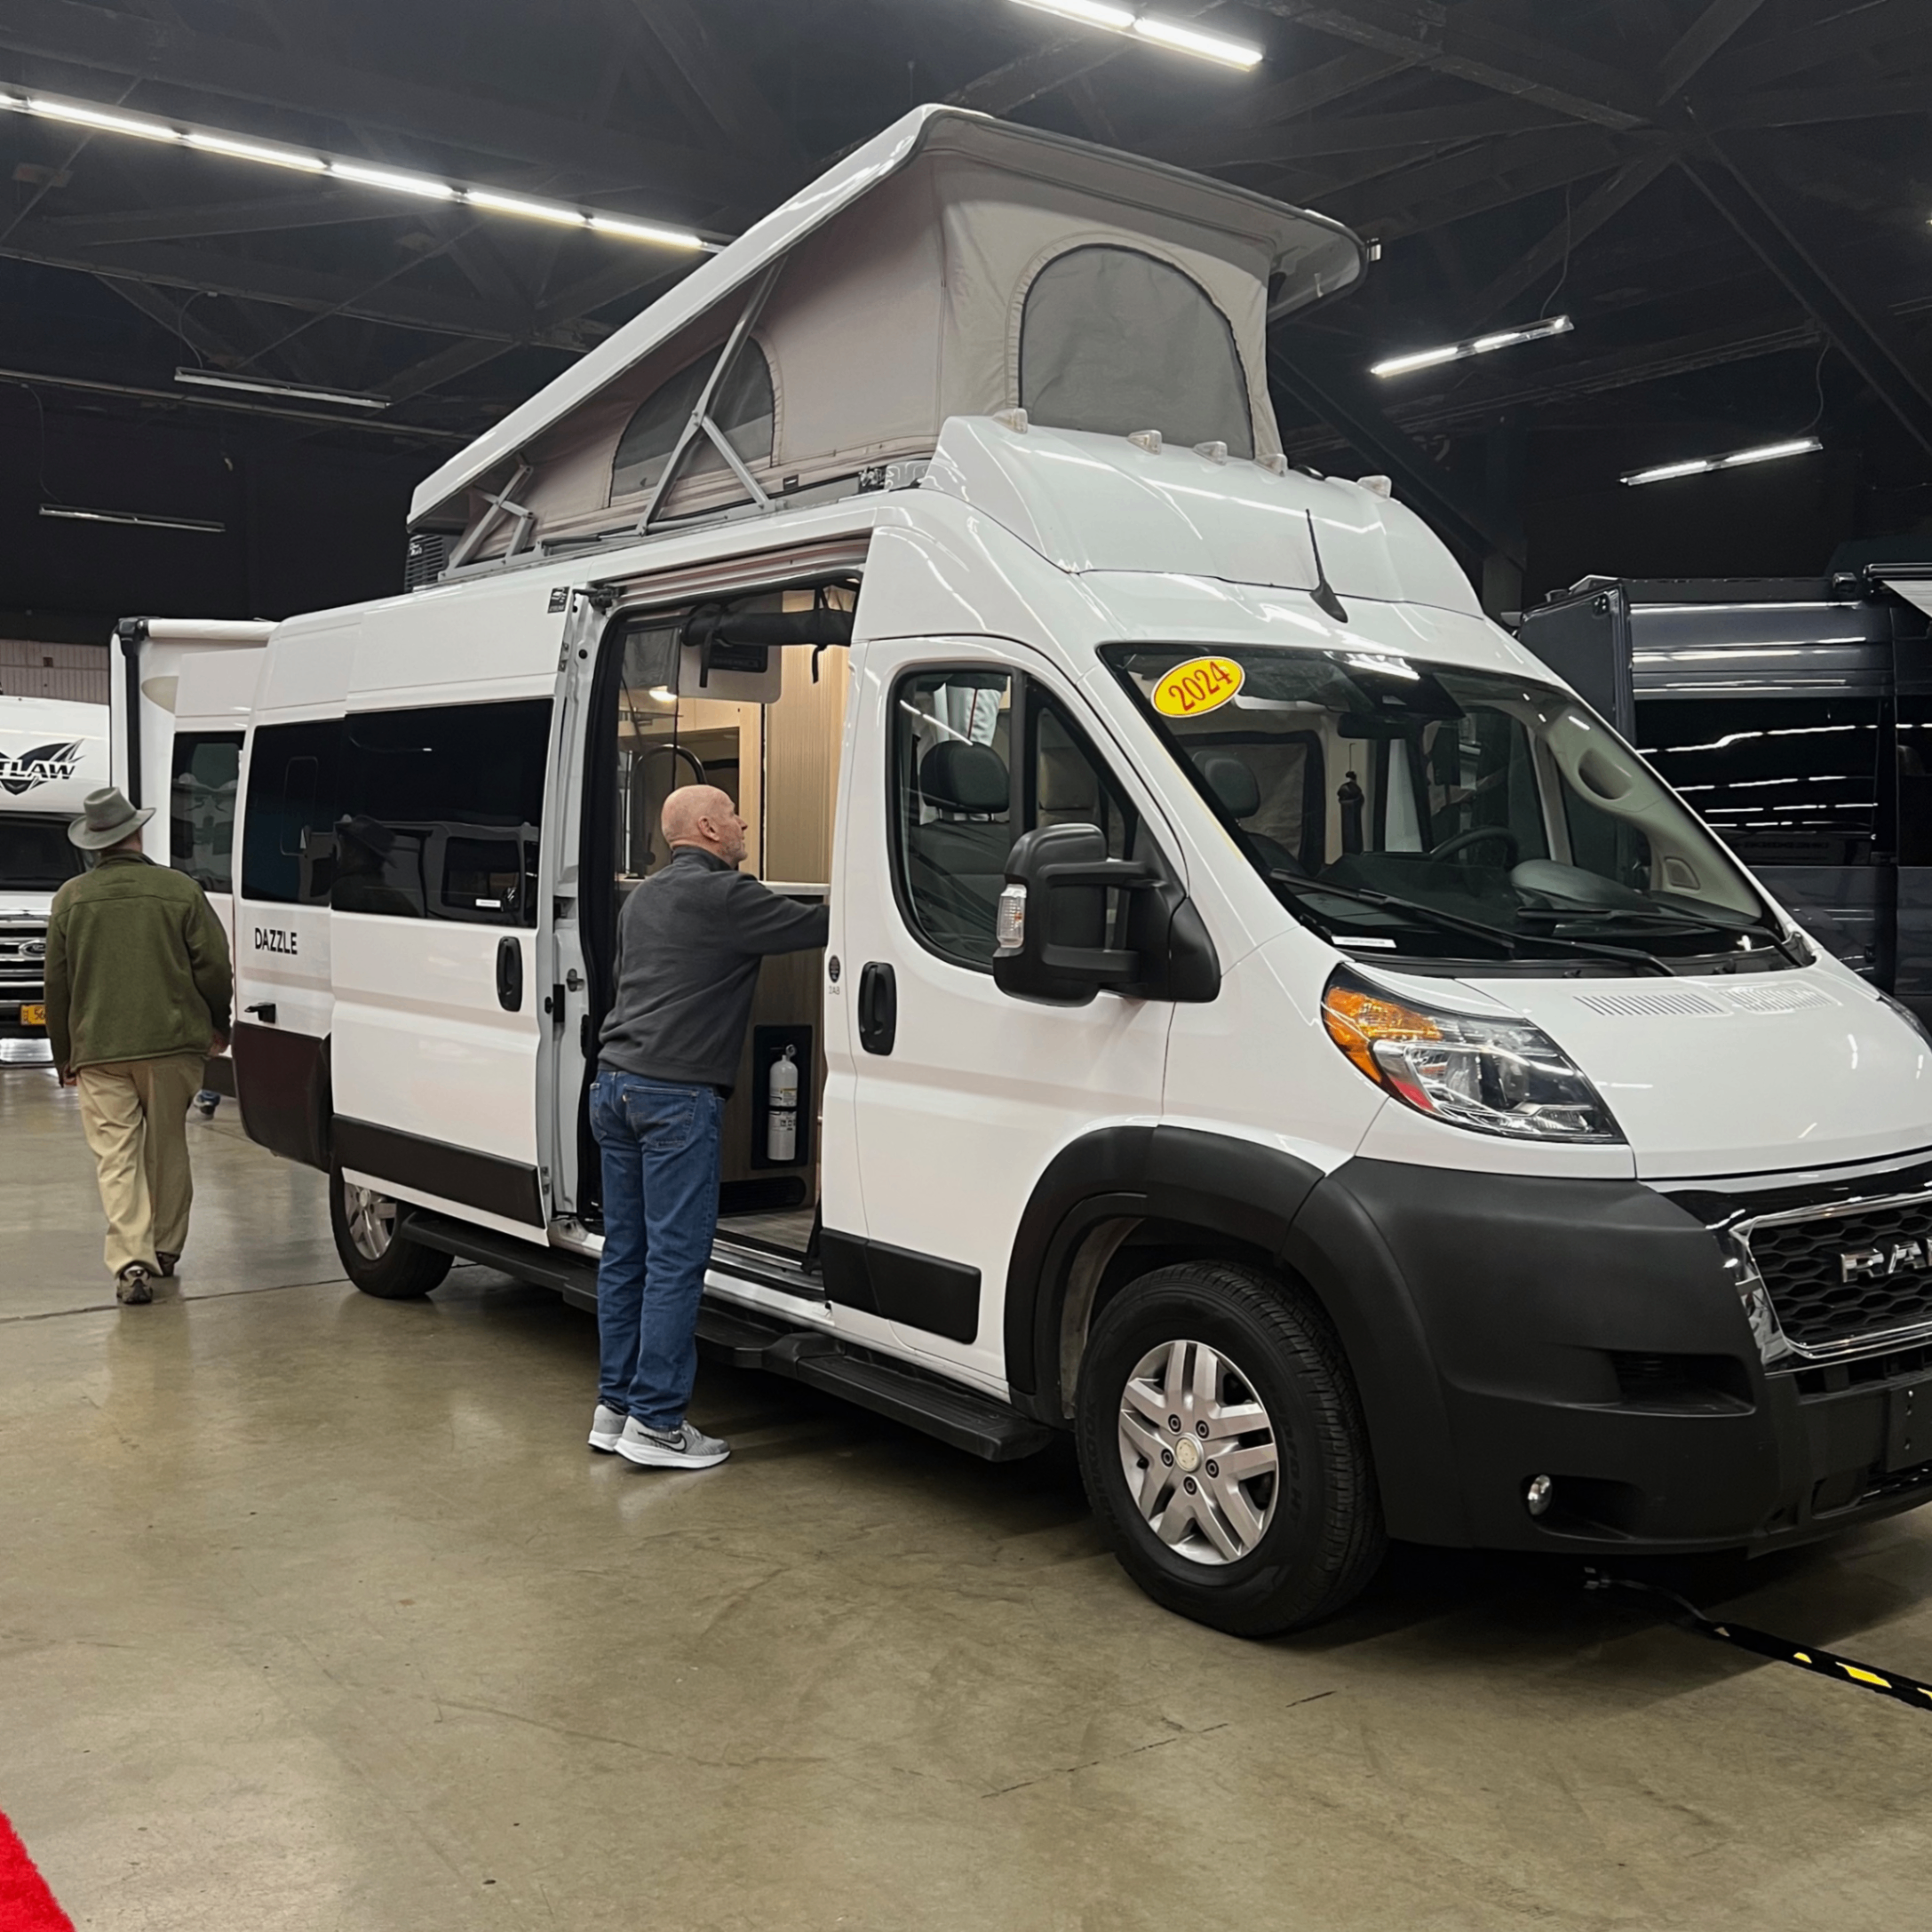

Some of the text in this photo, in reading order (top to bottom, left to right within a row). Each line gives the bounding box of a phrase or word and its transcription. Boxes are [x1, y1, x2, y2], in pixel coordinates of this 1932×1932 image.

[1169, 661, 1233, 711] 2024
[255, 927, 298, 955] DAZZLE
[1841, 1236, 1932, 1283] RA
